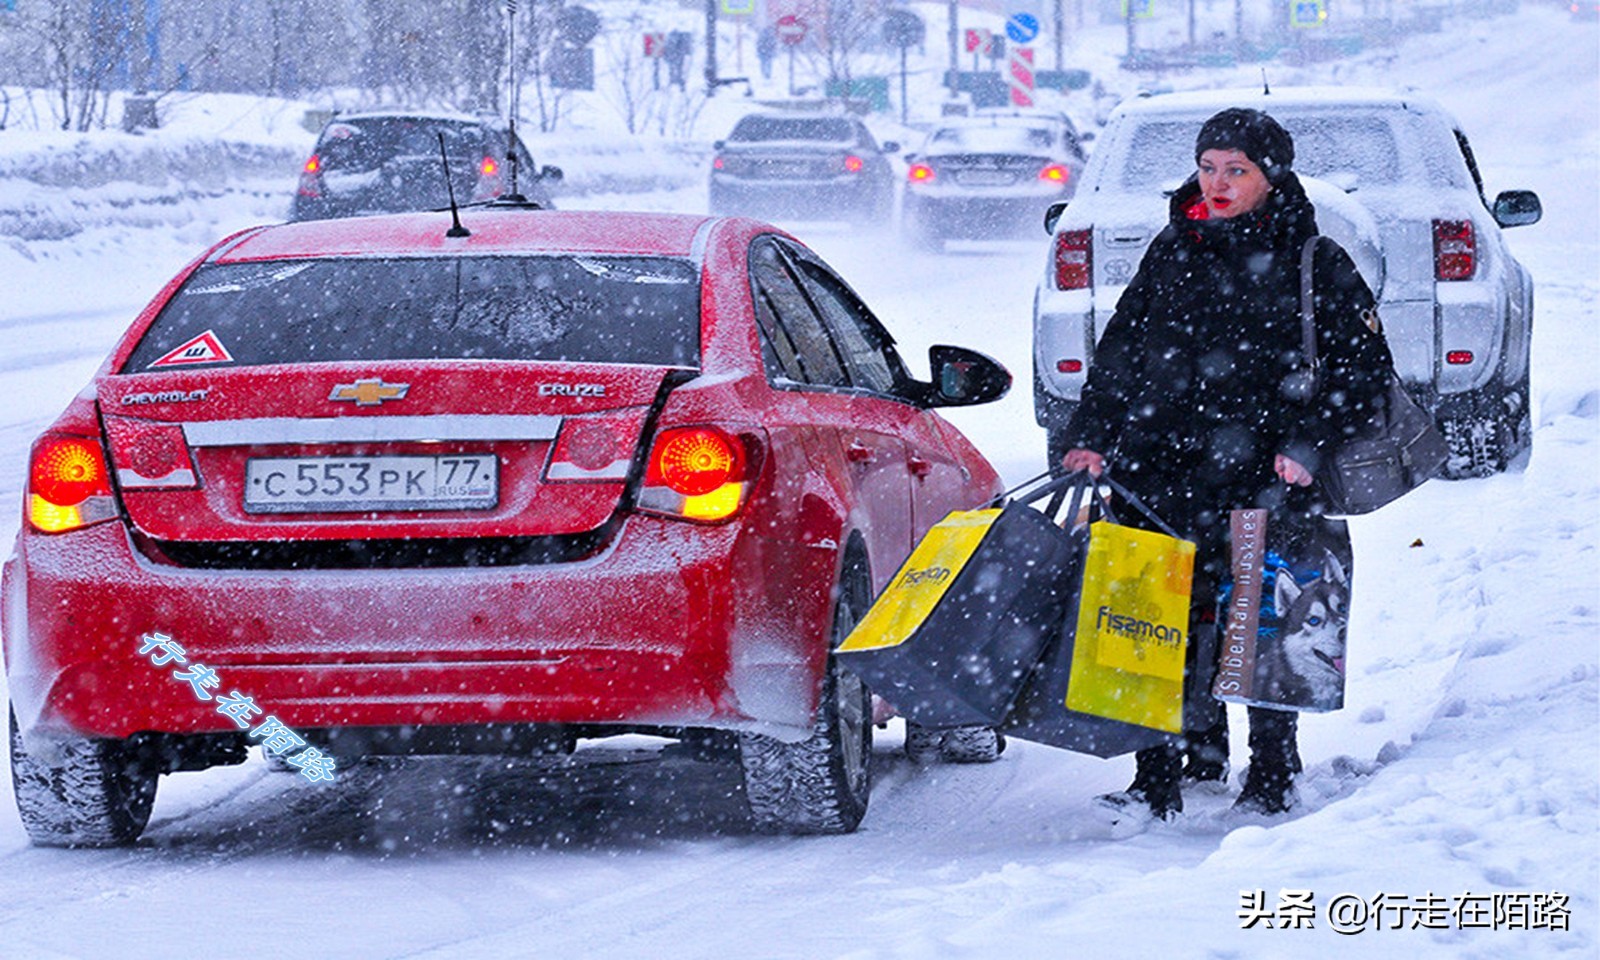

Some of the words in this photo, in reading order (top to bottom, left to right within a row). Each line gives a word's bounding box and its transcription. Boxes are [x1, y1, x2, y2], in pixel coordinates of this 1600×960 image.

[184, 347, 207, 358] Ш
[121, 389, 209, 405] CHEVROLET
[538, 383, 606, 398] CRUZE
[442, 459, 481, 485] 77
[438, 487, 469, 496] RUS
